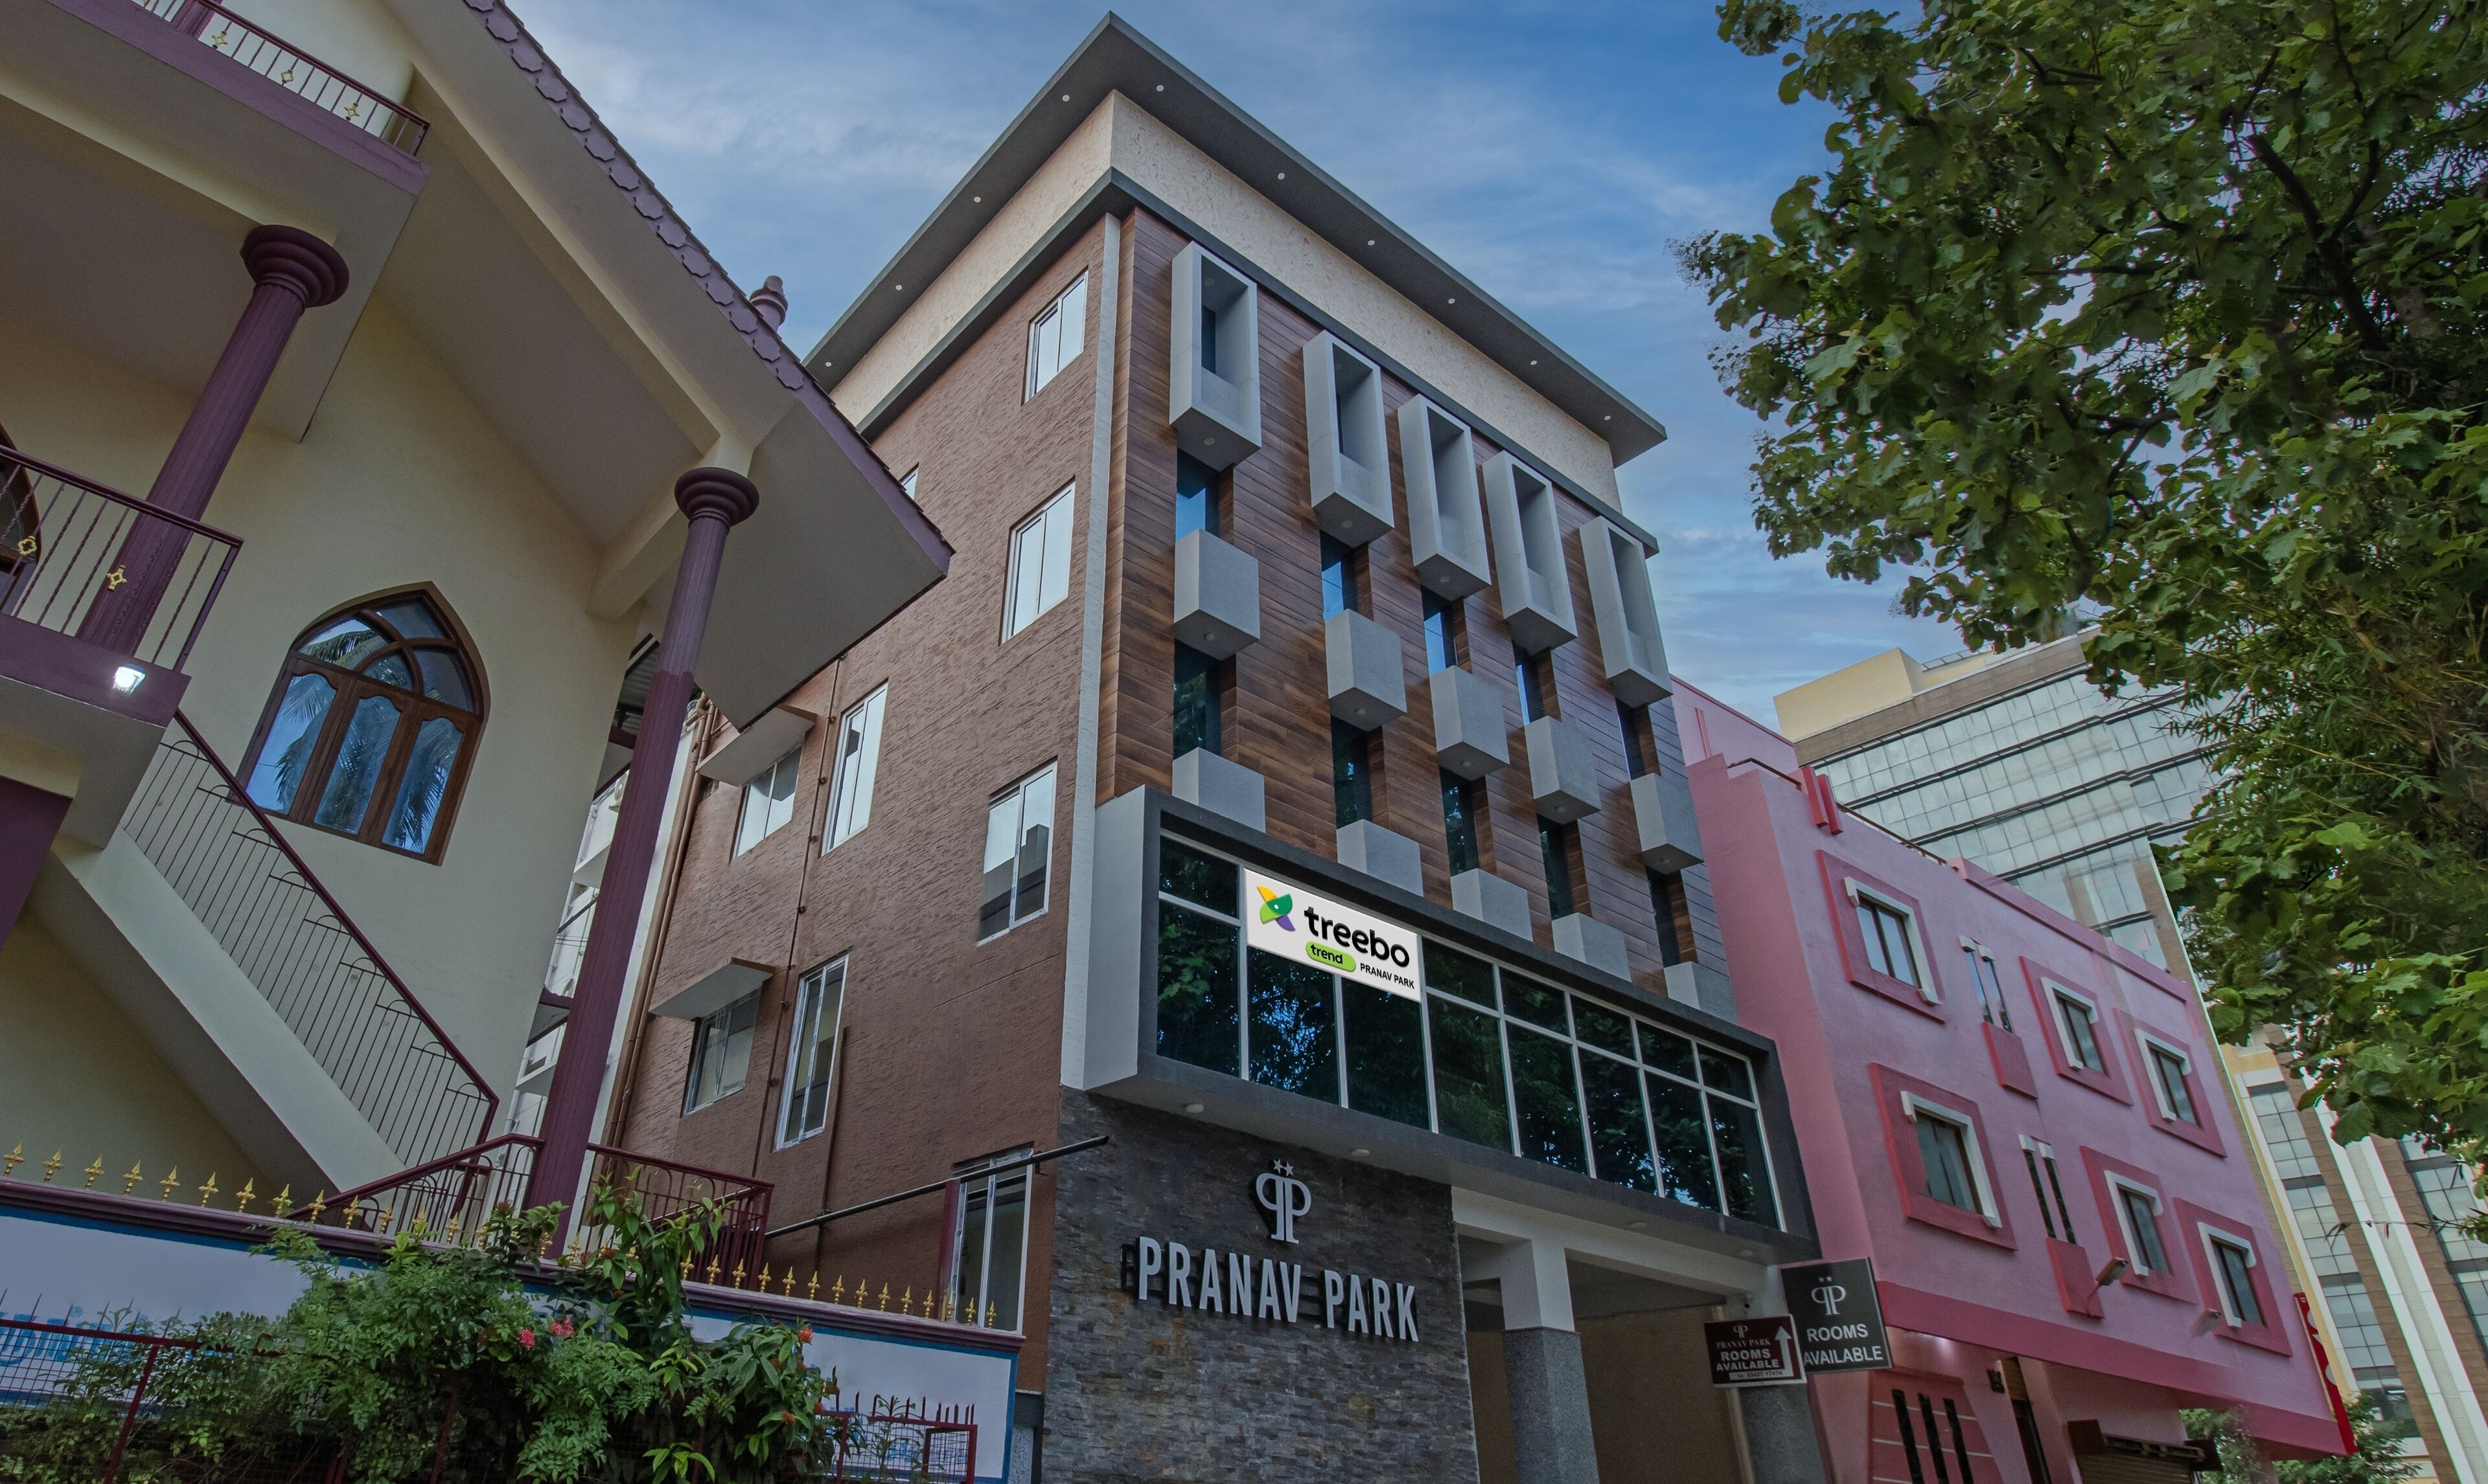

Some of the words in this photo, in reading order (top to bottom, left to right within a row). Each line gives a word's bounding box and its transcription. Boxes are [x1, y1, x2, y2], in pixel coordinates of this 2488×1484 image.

[1304, 906, 1410, 967] treebo
[1310, 944, 1343, 965] trend
[1360, 963, 1392, 981] PRANAV
[1394, 974, 1414, 989] PARK
[1138, 1237, 1301, 1323] PRANAV
[1324, 1269, 1419, 1342] PARK
[1806, 1324, 1869, 1343] ROOMS
[1716, 1341, 1747, 1349] PRANAV
[1749, 1338, 1772, 1347] PARK
[1716, 1359, 1780, 1371] AVAILABLE
[1721, 1349, 1771, 1362] ROOMS
[1804, 1346, 1883, 1365] AVAILABLE
